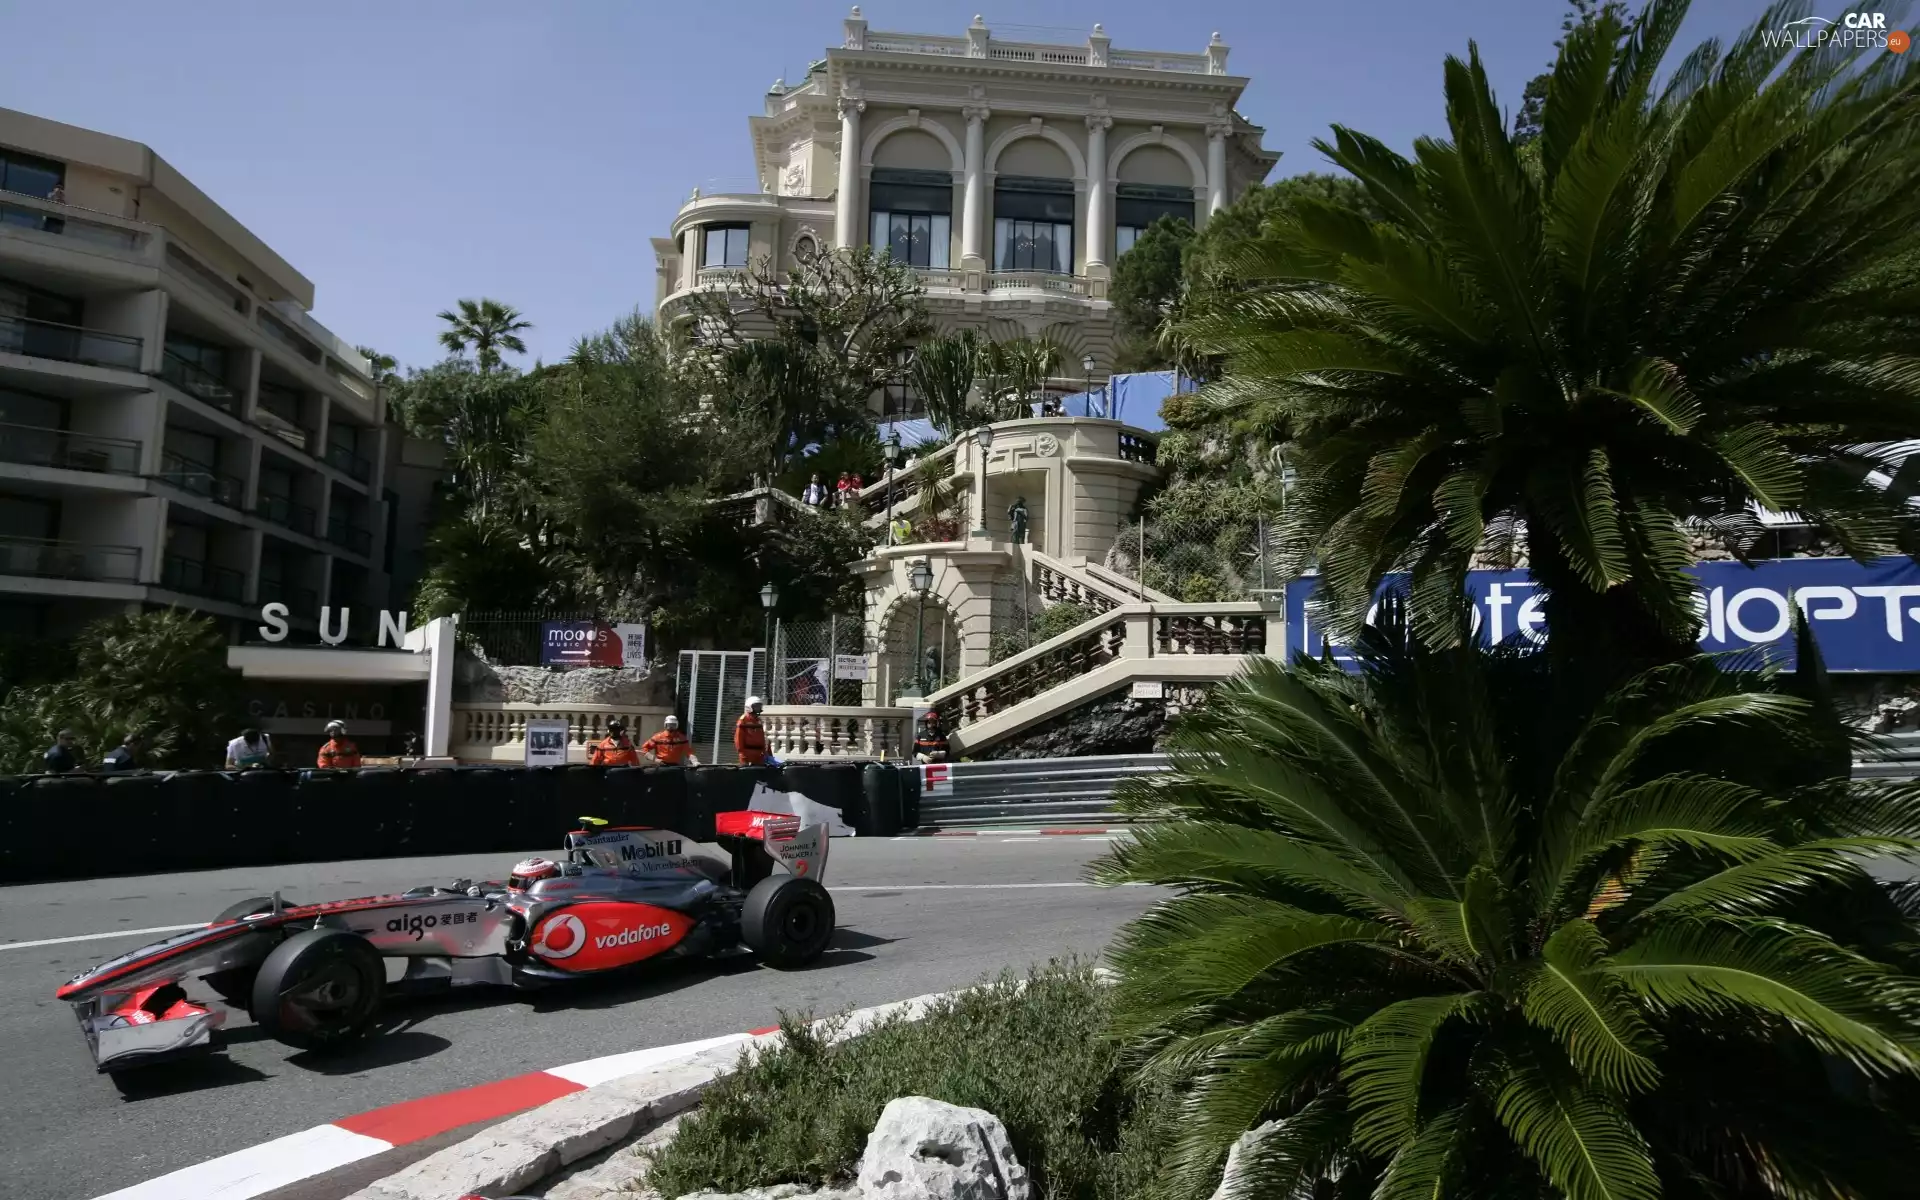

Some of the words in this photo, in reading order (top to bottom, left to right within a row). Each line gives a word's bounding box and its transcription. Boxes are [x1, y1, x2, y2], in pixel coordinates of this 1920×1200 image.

[259, 602, 407, 648] SUN
[549, 627, 608, 641] moods
[249, 699, 386, 720] CASINO
[926, 764, 948, 791] F
[586, 832, 630, 846] Santander
[780, 843, 810, 852] JOHNNIE
[621, 841, 664, 861] Mobil
[386, 913, 437, 941] aigo
[595, 922, 671, 949] vodafone
